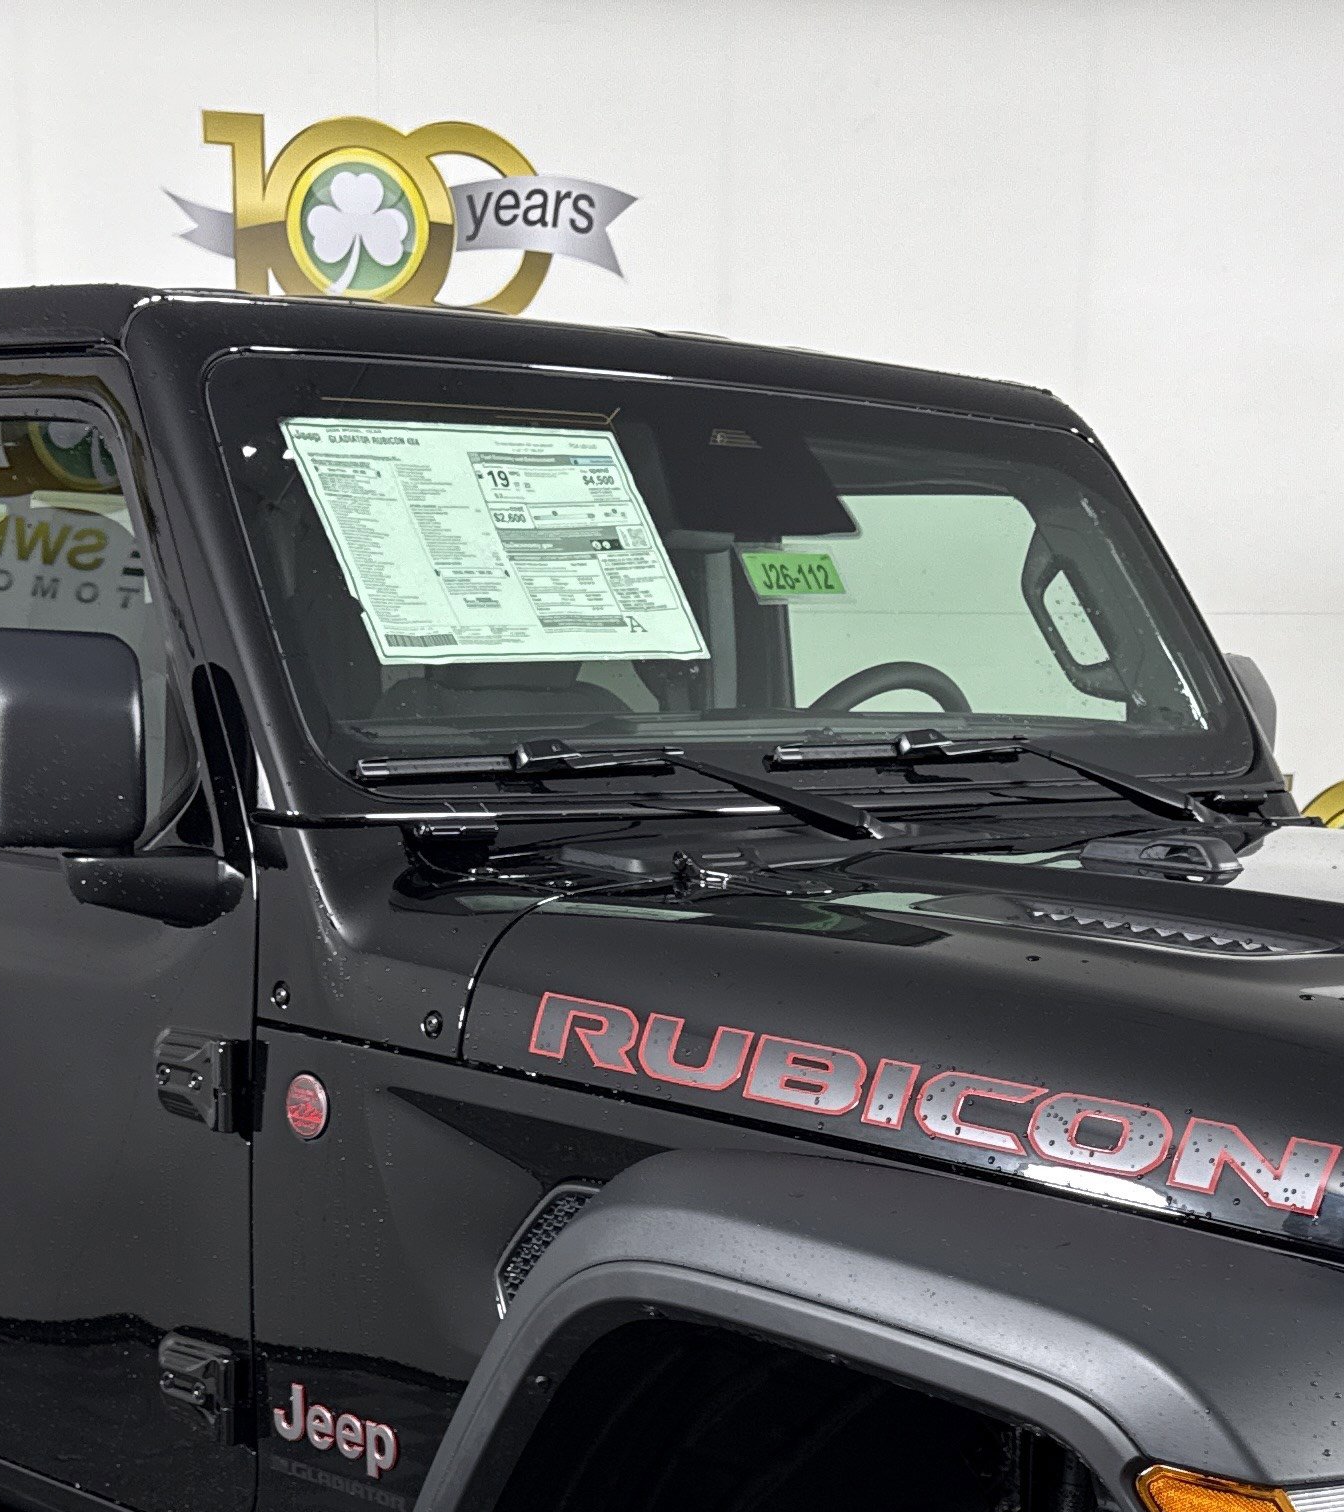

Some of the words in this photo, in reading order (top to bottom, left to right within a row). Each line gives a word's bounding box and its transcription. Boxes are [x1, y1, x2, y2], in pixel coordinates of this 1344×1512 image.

[466, 186, 597, 242] years
[487, 470, 511, 488] 19
[582, 475, 615, 486] $4,500
[761, 563, 835, 591] J26-112
[529, 992, 1342, 1216] RUBICON
[272, 1381, 399, 1480] Jeep
[290, 1461, 408, 1512] GLADIATOR
